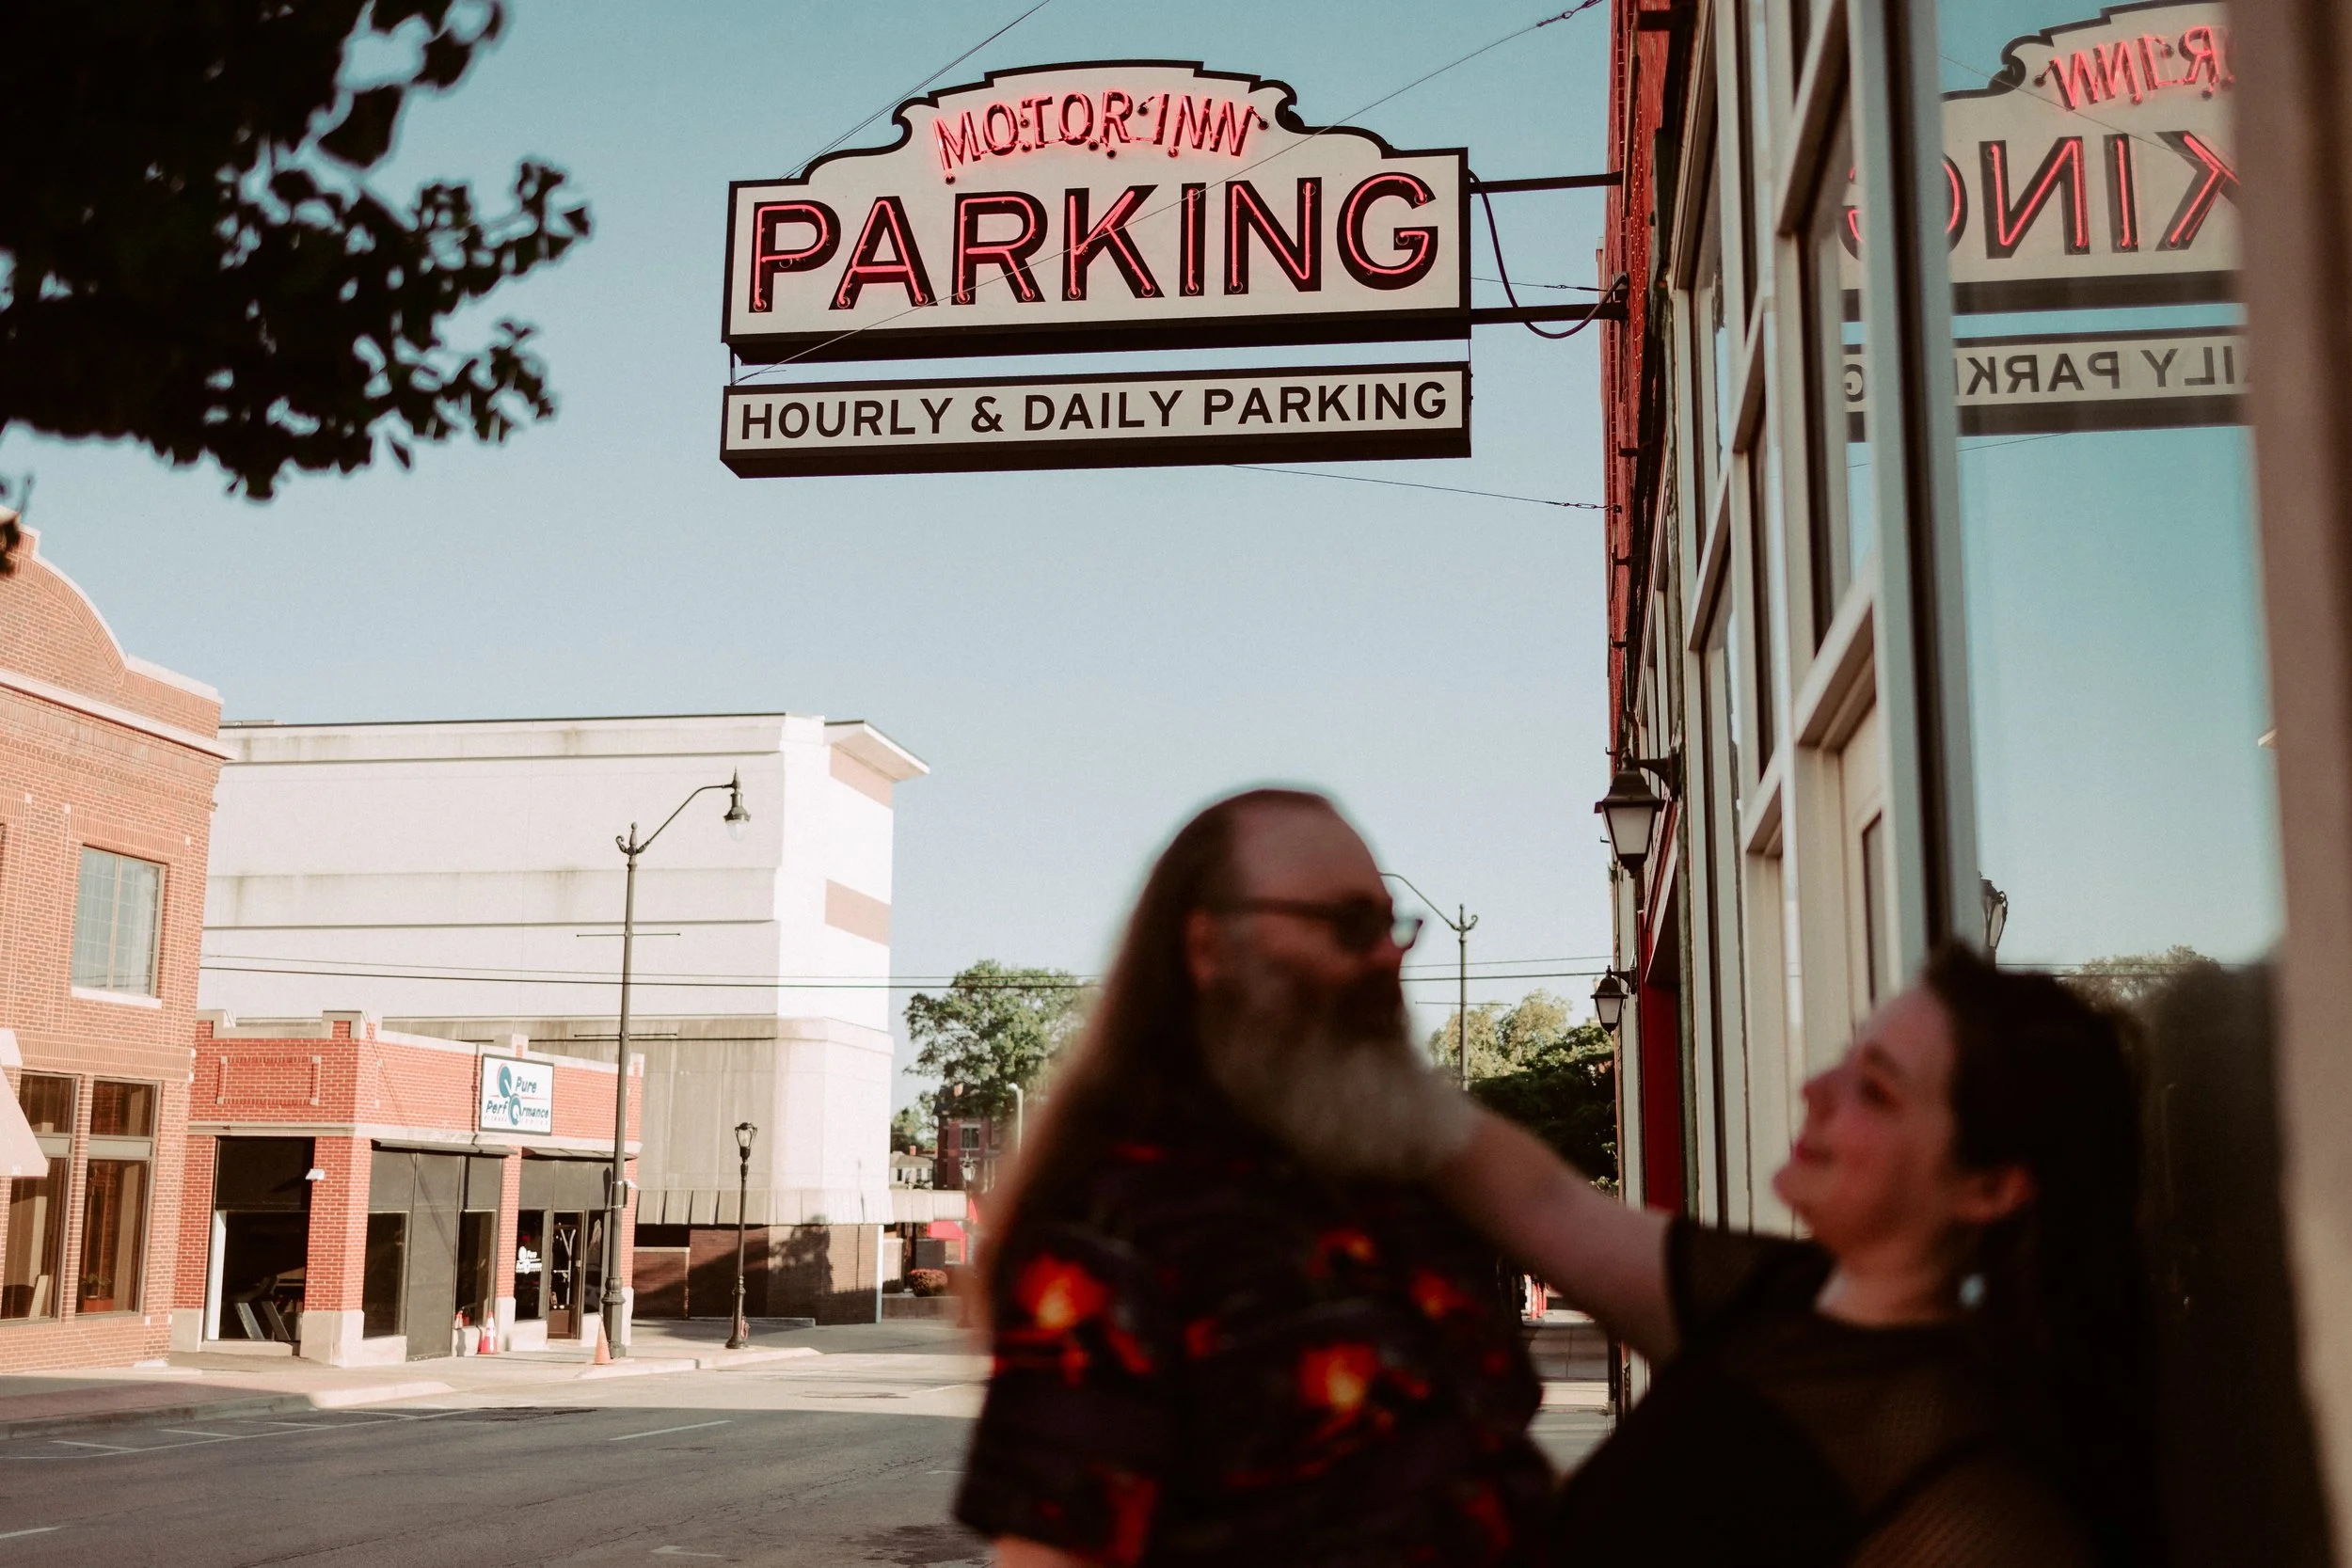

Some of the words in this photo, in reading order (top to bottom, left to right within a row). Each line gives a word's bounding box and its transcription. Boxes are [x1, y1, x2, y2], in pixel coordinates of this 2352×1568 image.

[932, 89, 1134, 167] MOTOR
[1152, 93, 1254, 158] INN
[748, 172, 1439, 313] PARKING
[740, 396, 954, 440] HOURLY
[970, 396, 1004, 433] &
[1023, 389, 1184, 430] DAILY
[1202, 380, 1449, 425] PARKING
[515, 1076, 537, 1093] Pure
